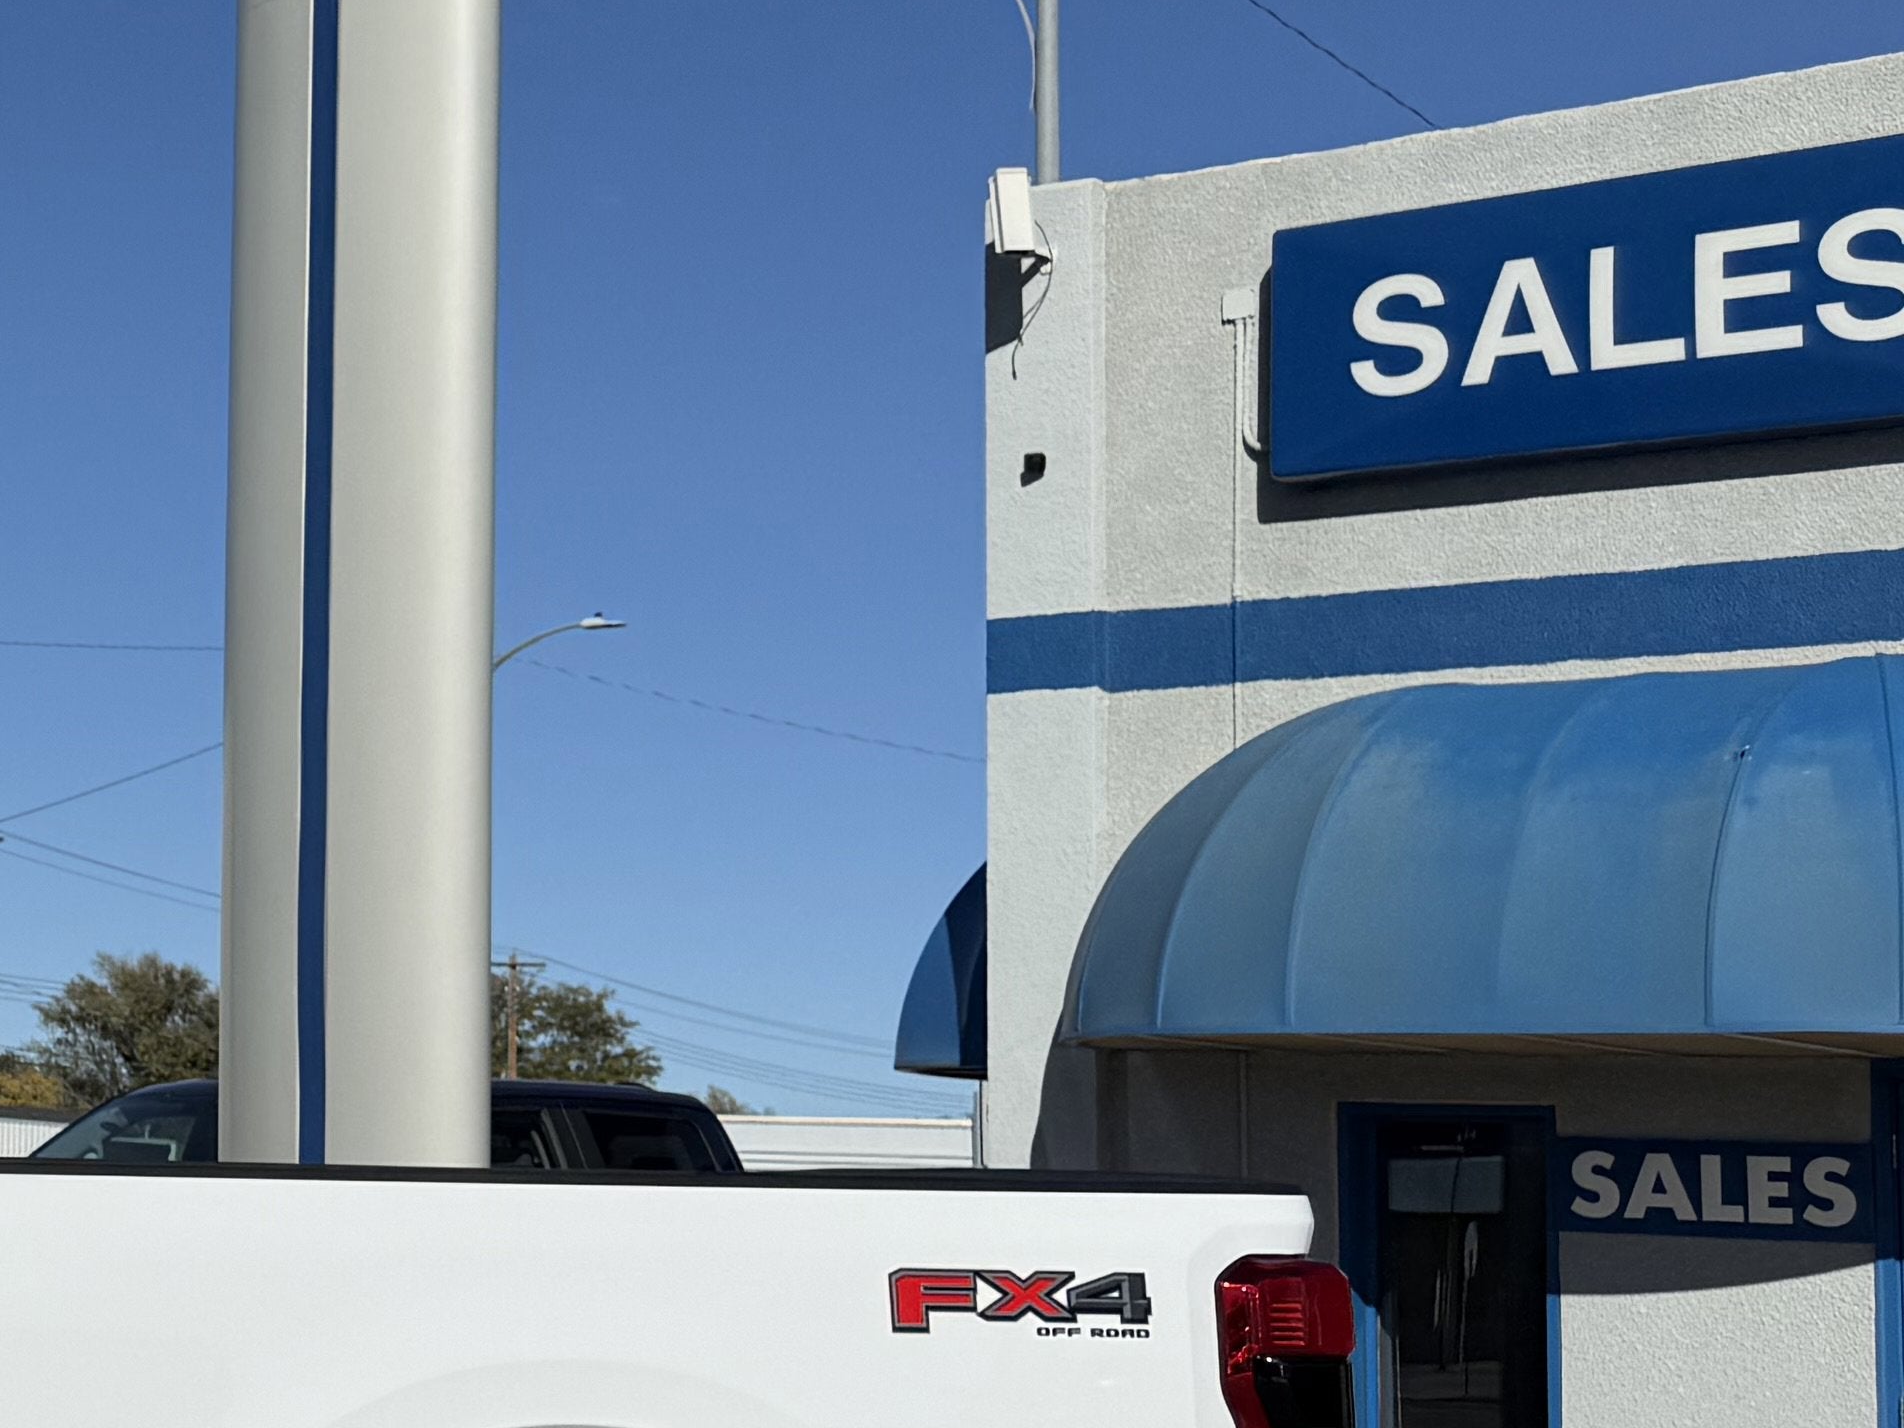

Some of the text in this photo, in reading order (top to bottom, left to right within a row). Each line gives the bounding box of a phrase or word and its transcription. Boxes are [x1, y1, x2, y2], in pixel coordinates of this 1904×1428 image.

[1350, 207, 1904, 398] SALES
[1570, 1150, 1857, 1227] SALES
[888, 1268, 1152, 1334] FX4
[1036, 1327, 1150, 1339] OFF ROAD
